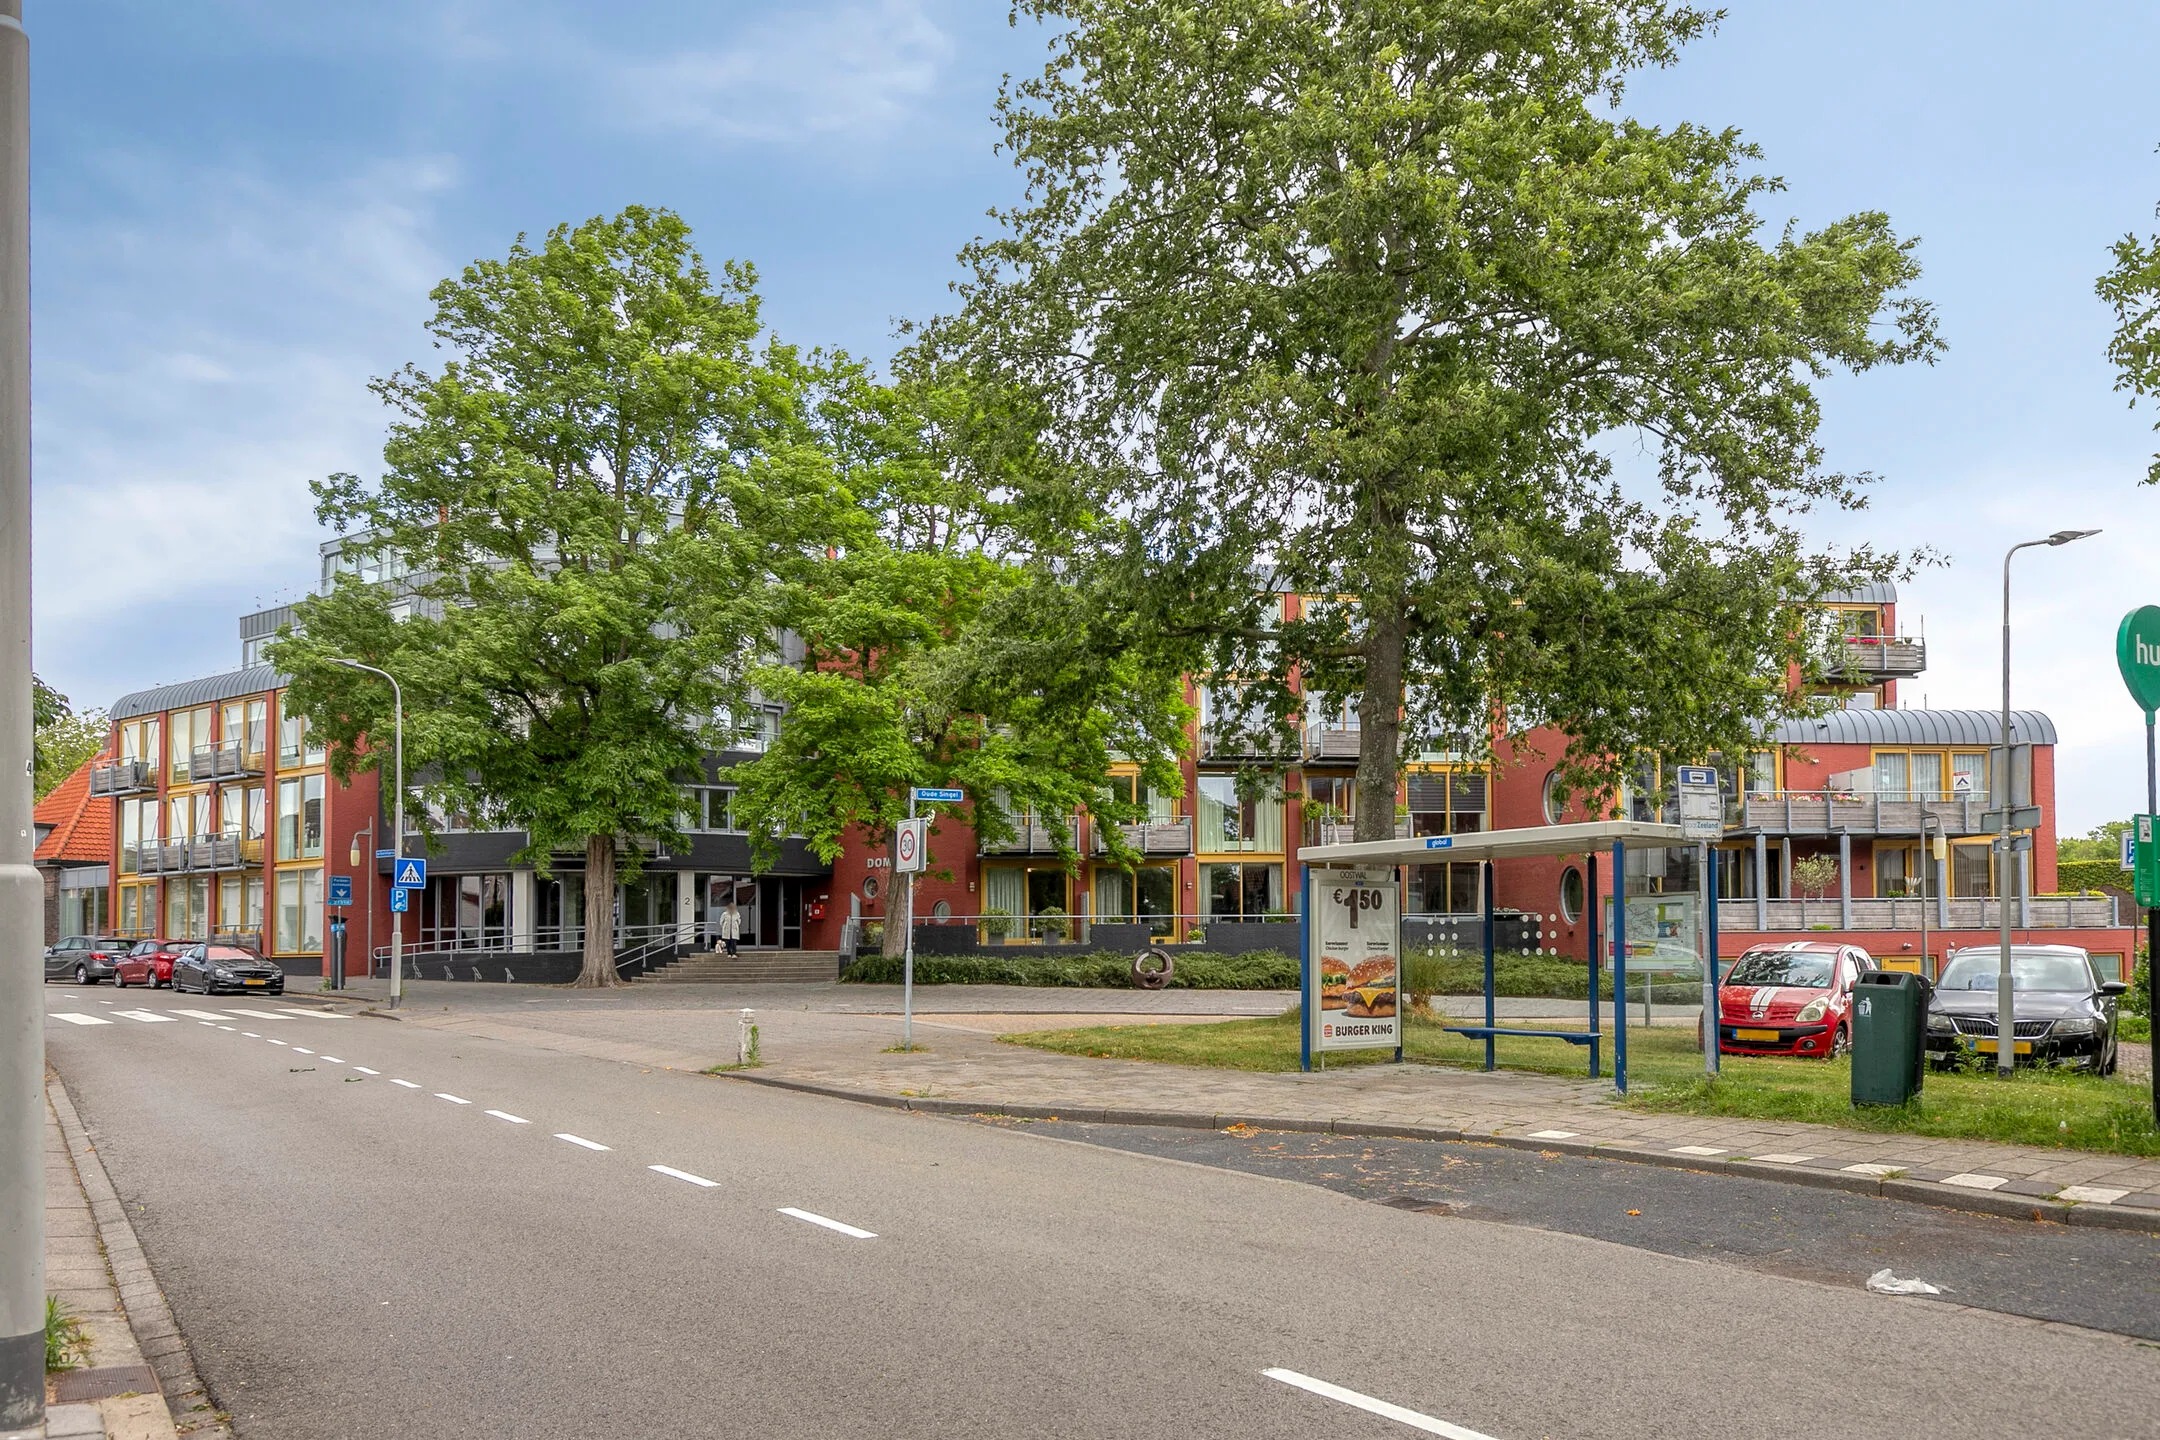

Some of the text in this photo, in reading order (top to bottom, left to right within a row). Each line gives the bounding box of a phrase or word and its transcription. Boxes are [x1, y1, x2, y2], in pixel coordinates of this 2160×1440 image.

[939, 791, 959, 799] Singel
[902, 839, 912, 852] 30
[1431, 838, 1448, 848] global
[1340, 871, 1367, 879] OOSTWAL
[396, 891, 404, 901] P
[684, 897, 691, 905] 2
[1335, 1025, 1370, 1037] BURGER
[1371, 1024, 1393, 1035] KING
